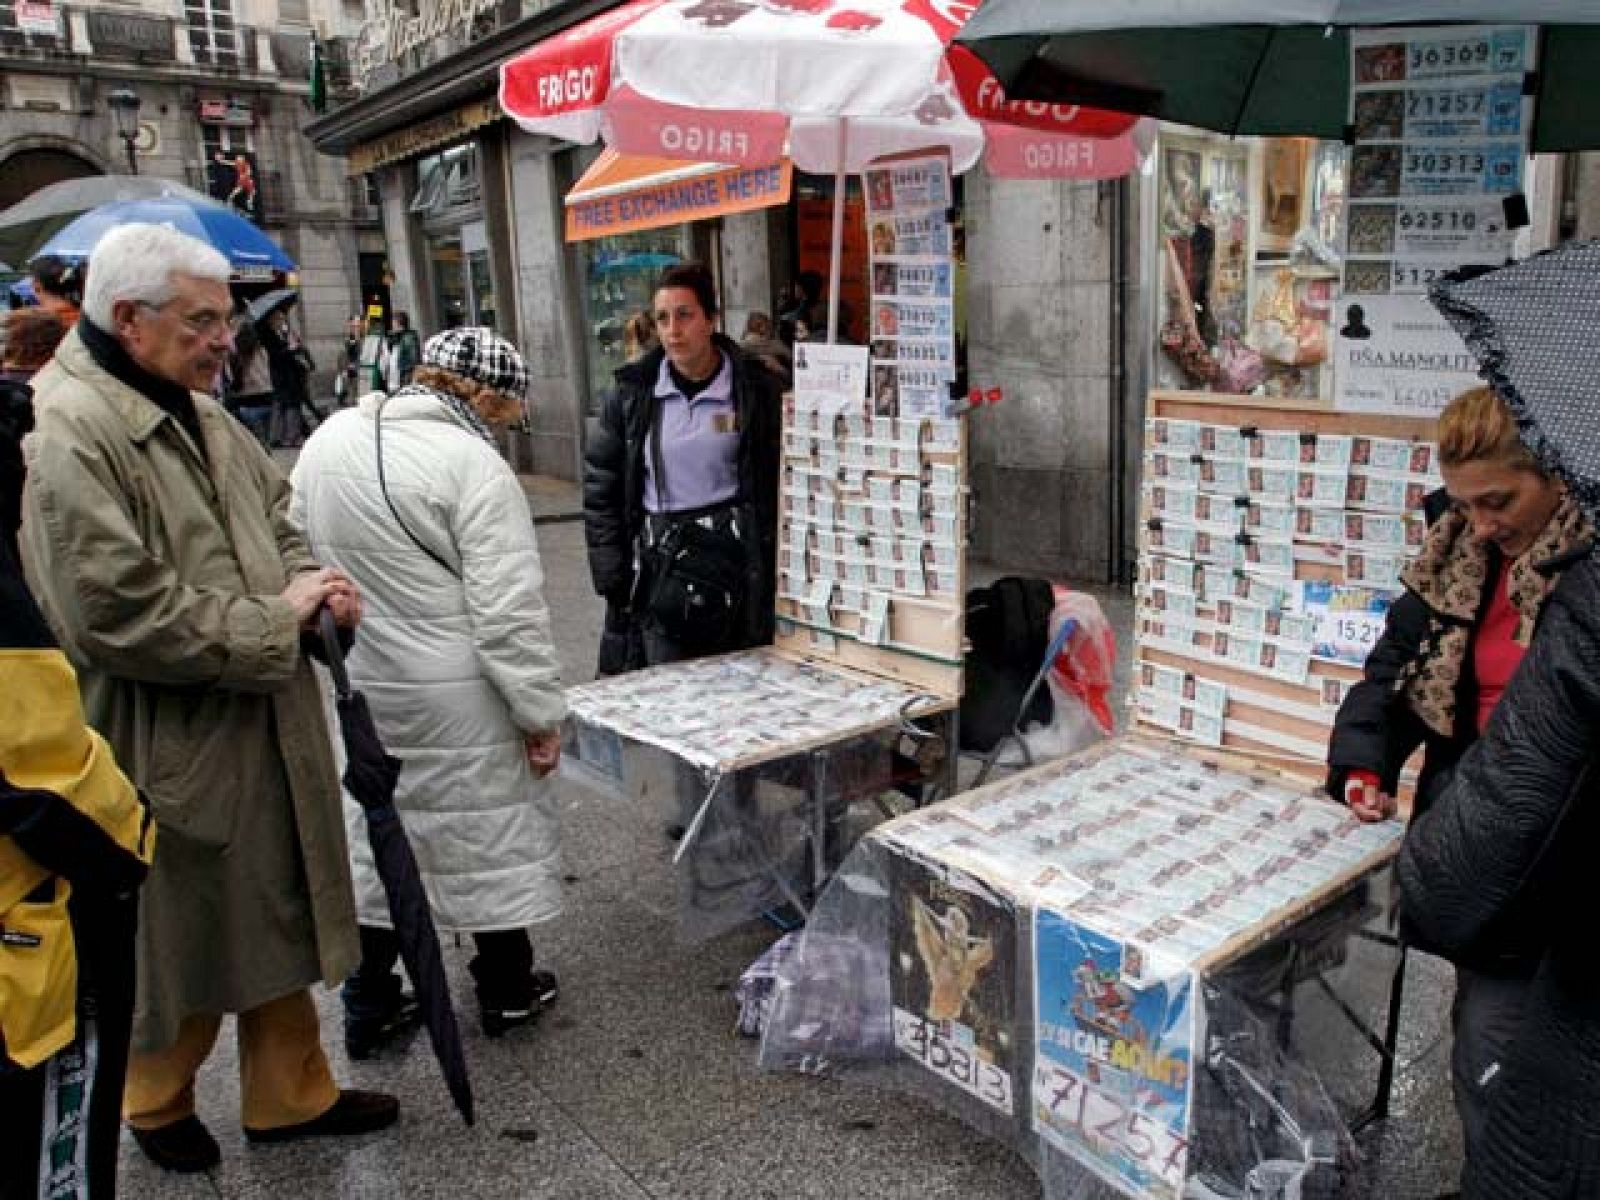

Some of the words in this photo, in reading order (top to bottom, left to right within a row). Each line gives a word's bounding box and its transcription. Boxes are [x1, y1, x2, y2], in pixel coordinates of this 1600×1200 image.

[538, 66, 597, 110] FRIGO
[574, 201, 614, 227] FREE
[619, 179, 719, 221] EXCHANGE
[725, 164, 782, 198] HERE
[1051, 1067, 1190, 1174] 71257
